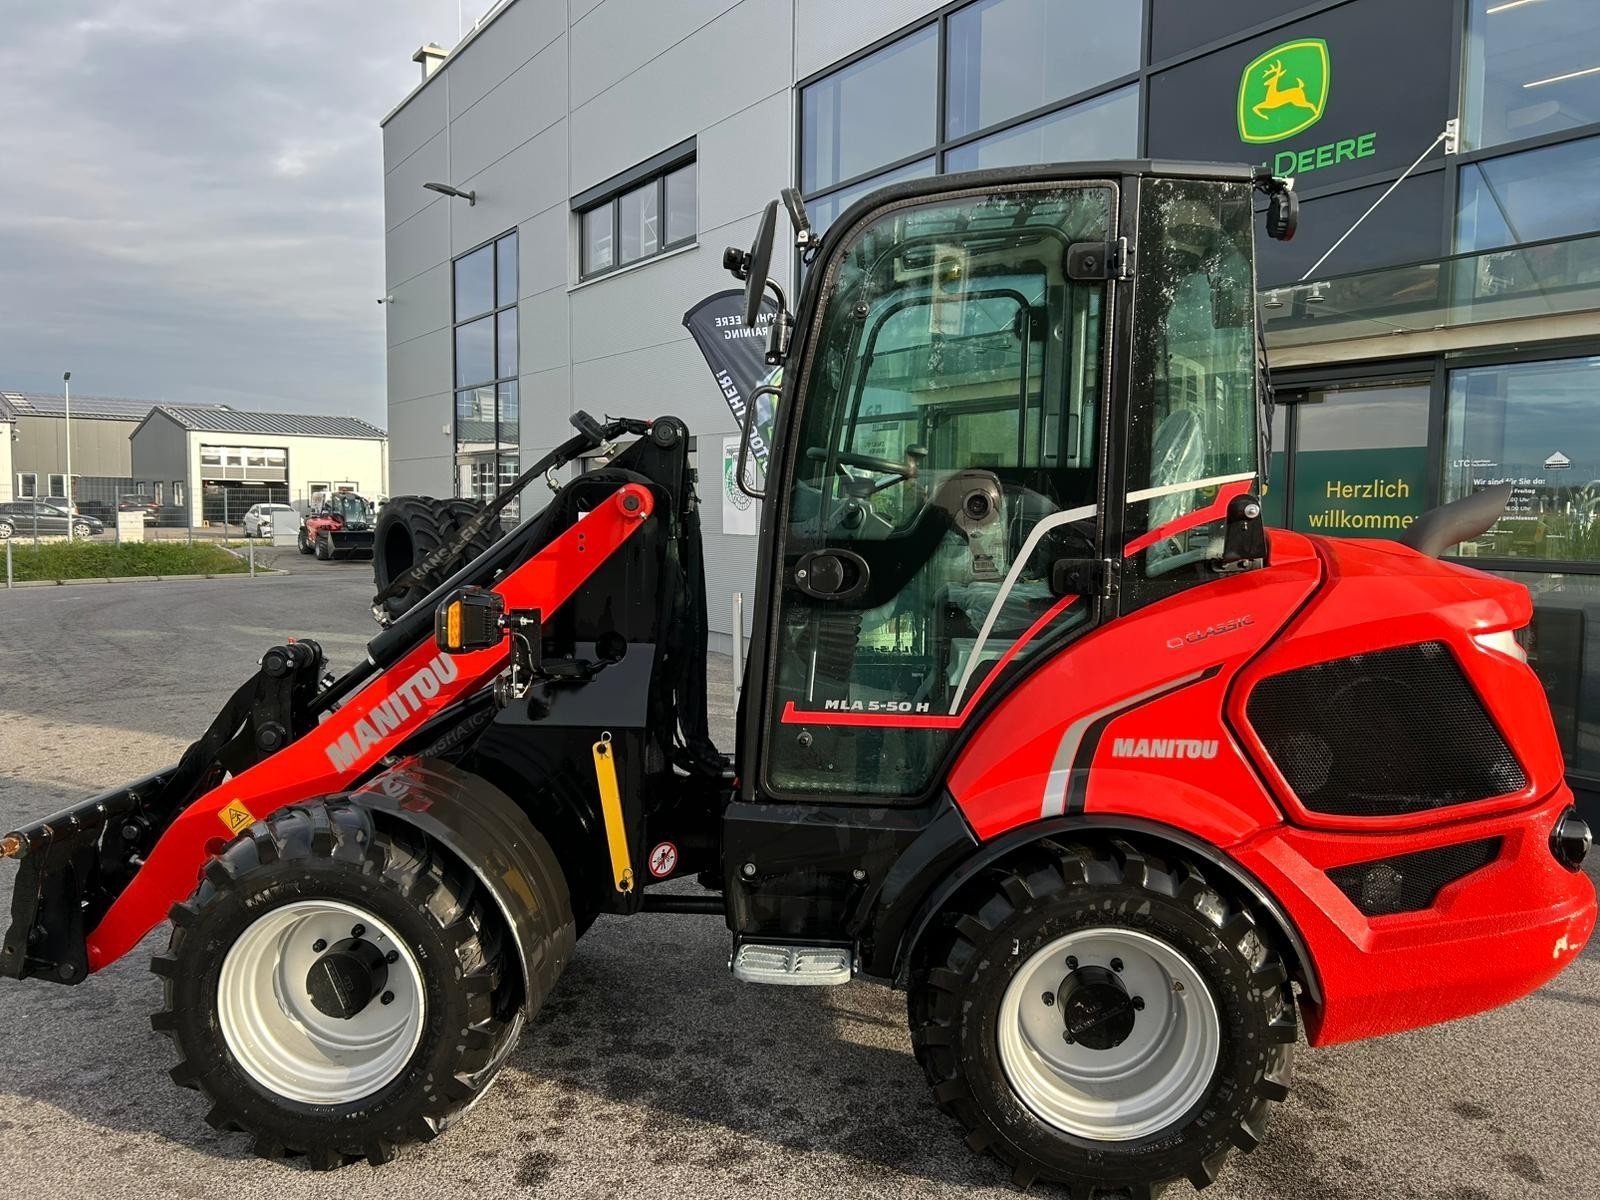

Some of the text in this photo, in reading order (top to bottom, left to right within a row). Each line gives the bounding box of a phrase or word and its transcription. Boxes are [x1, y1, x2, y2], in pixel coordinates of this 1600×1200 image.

[1274, 132, 1377, 178] DEERE
[1326, 478, 1409, 498] Herzlich
[1308, 509, 1419, 529] willkomme
[325, 652, 459, 774] MANITOU
[825, 699, 930, 712] MLA 5-50 H
[1112, 738, 1219, 759] MANITOU
